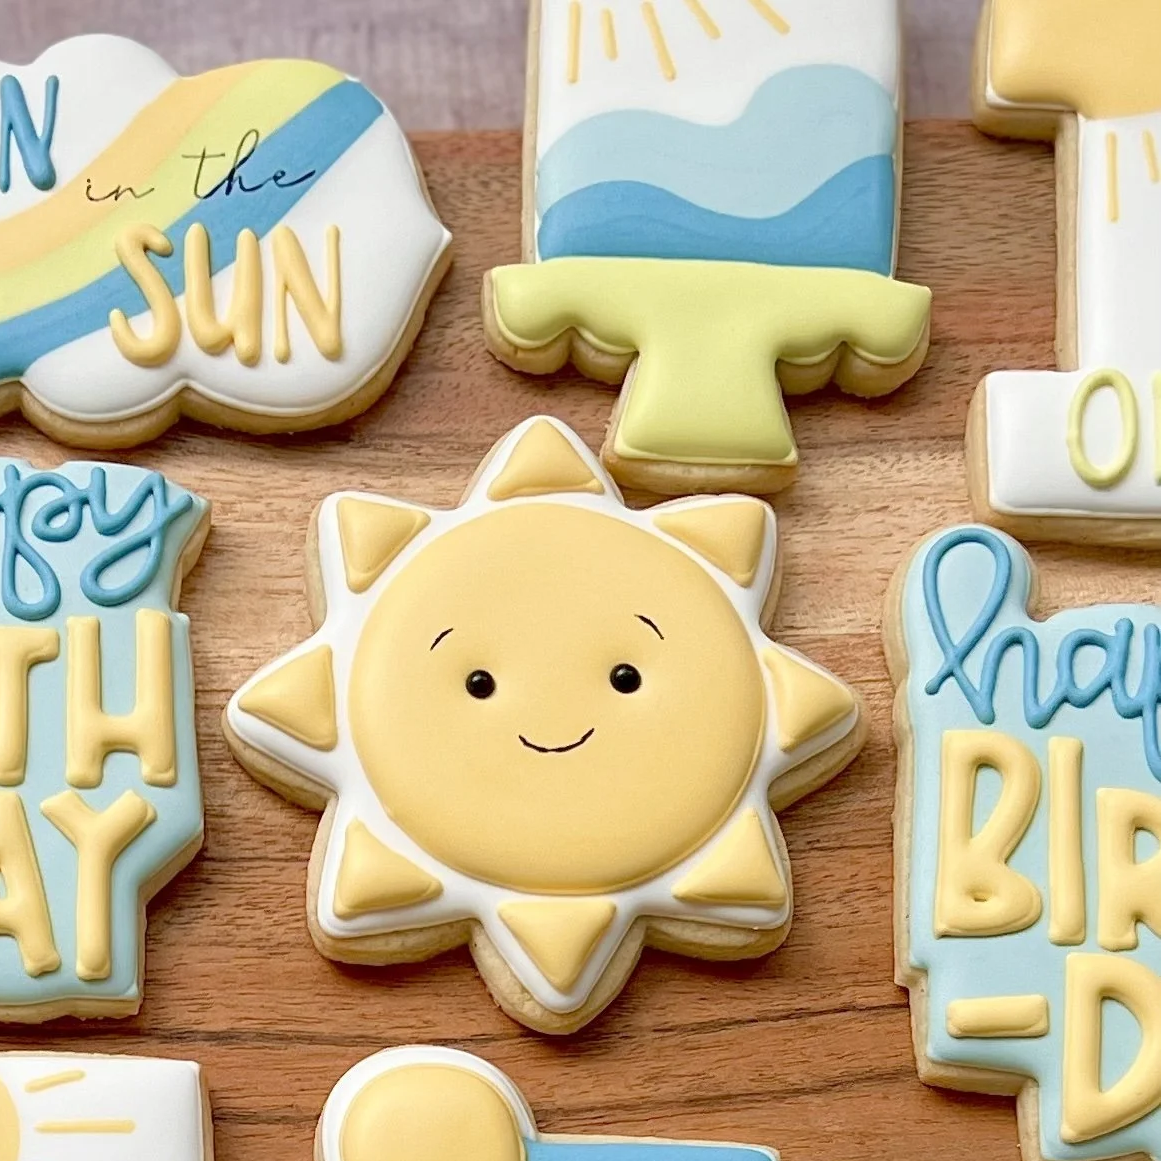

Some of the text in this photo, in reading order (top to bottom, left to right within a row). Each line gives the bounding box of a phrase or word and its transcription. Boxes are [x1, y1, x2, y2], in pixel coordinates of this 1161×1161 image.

[84, 129, 316, 203] in the
[108, 222, 342, 367] SUN
[1067, 368, 1161, 488] O
